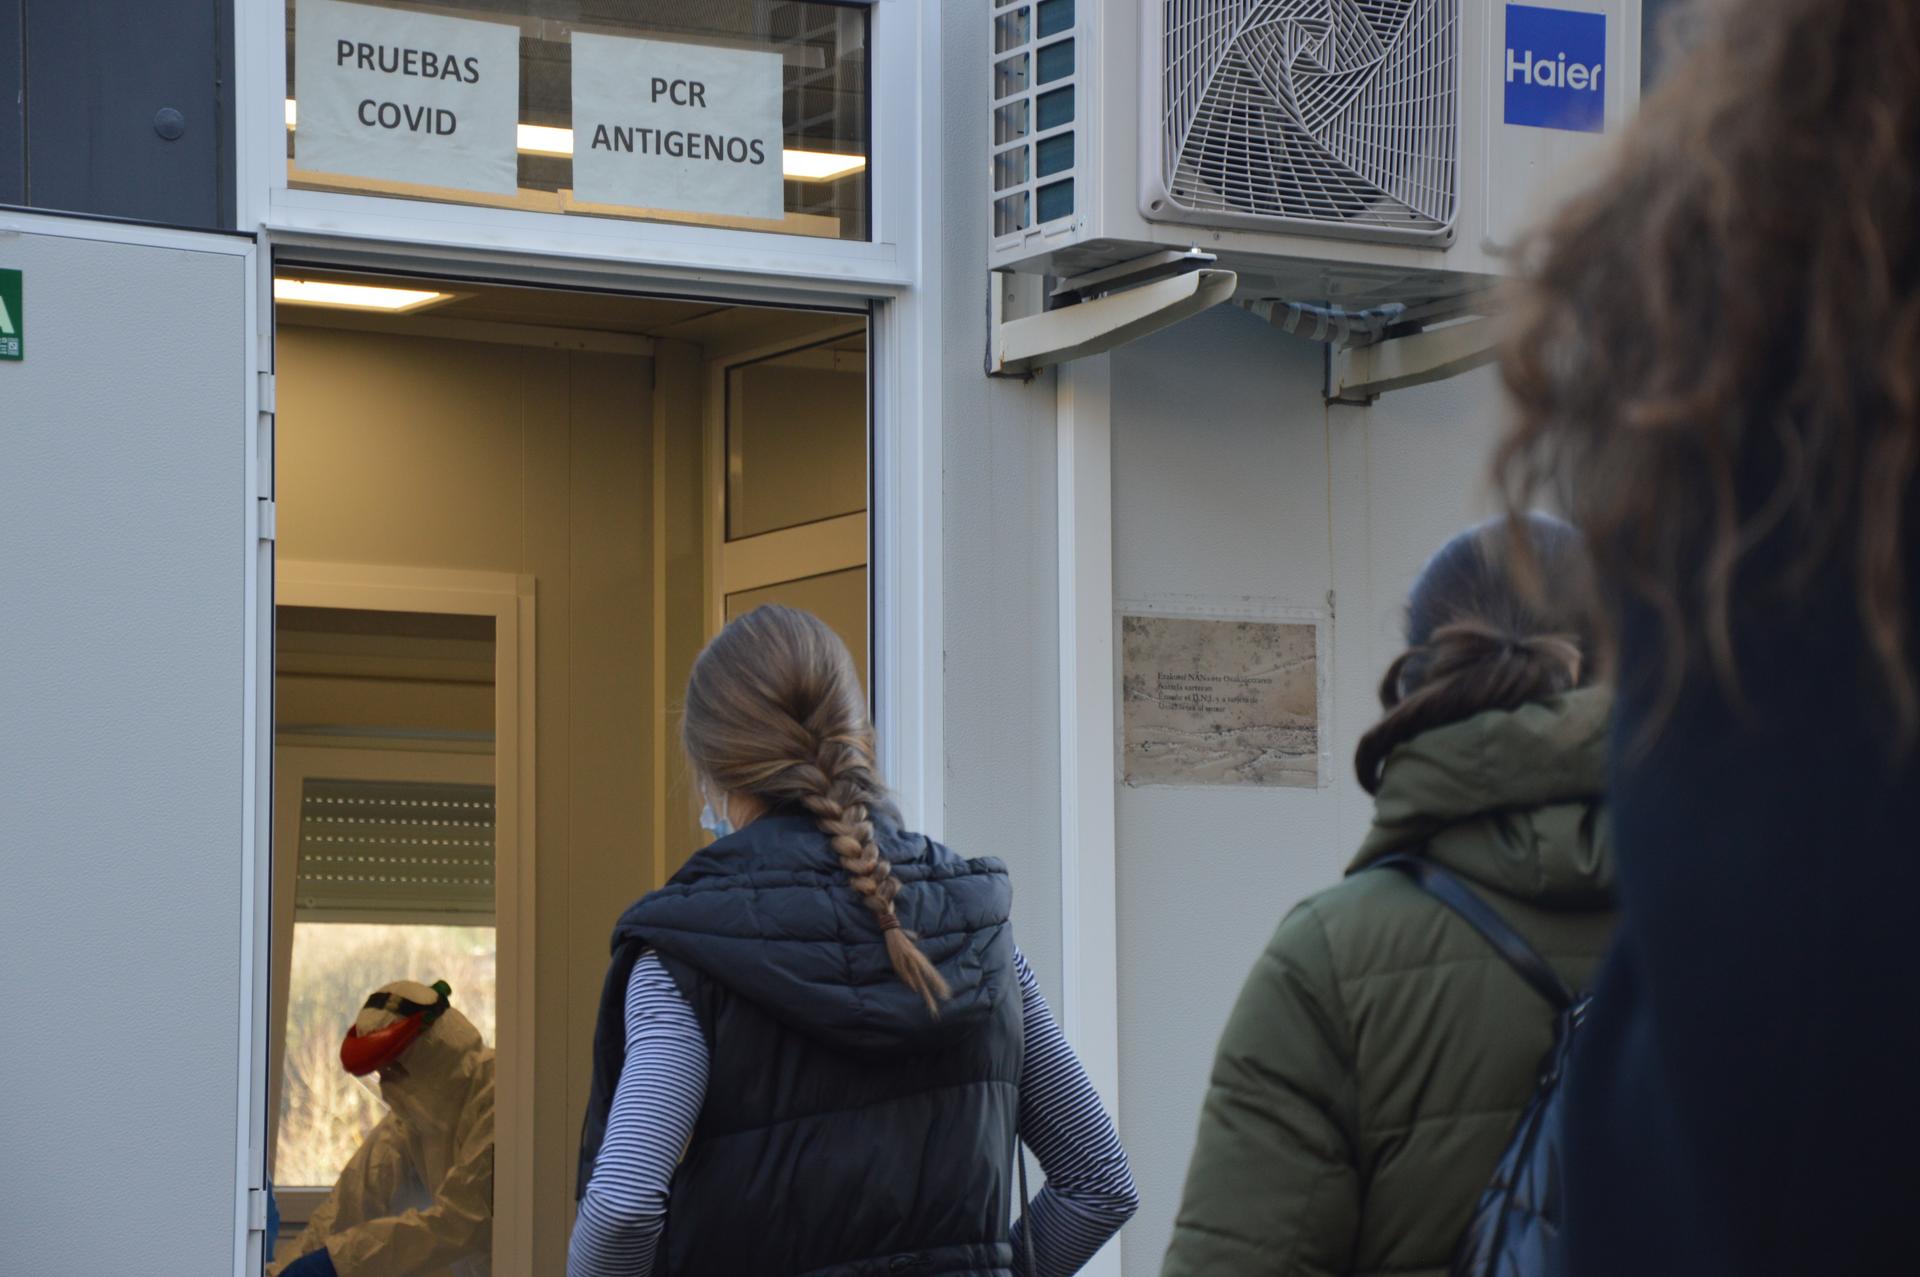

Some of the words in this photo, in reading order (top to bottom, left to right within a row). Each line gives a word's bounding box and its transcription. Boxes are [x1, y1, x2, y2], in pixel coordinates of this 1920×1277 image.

[337, 39, 480, 84] PRUEBAS
[1506, 48, 1602, 91] Haier
[651, 77, 706, 108] PCR
[358, 99, 457, 136] COVID
[591, 124, 765, 165] ANTIGENOS
